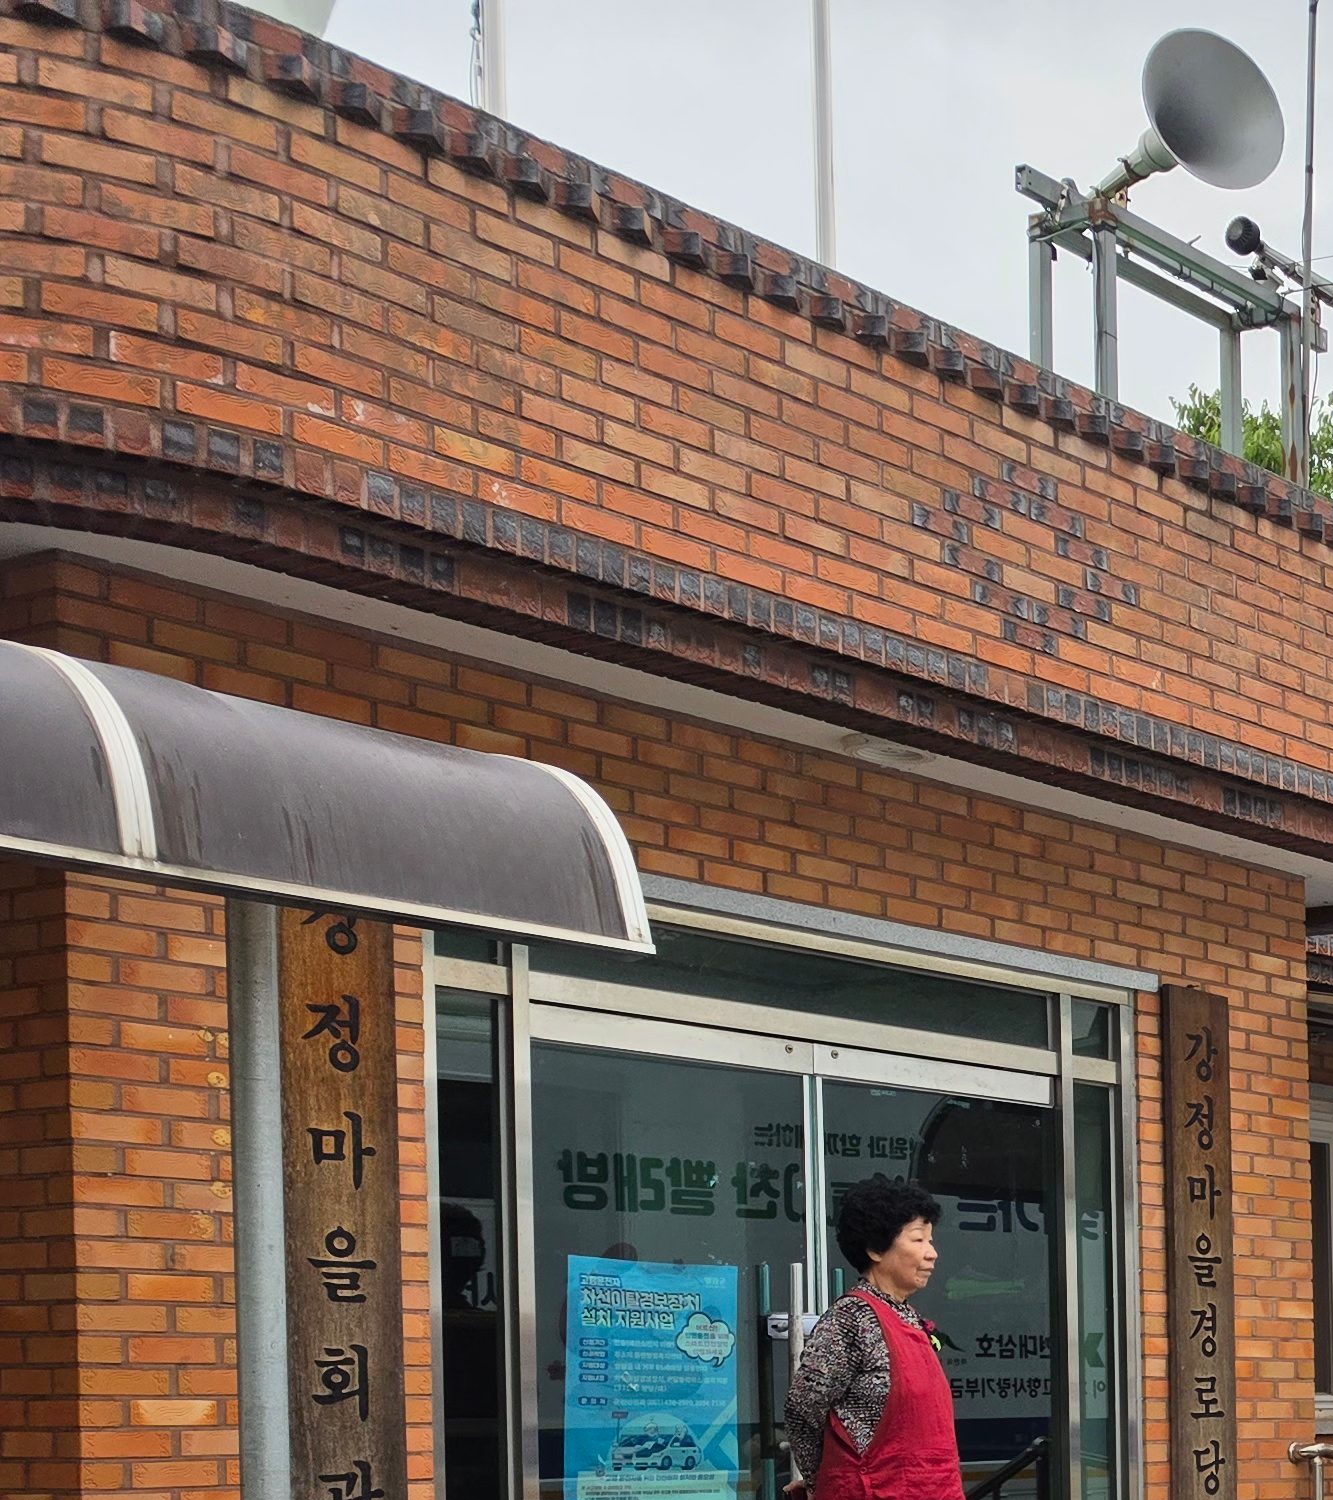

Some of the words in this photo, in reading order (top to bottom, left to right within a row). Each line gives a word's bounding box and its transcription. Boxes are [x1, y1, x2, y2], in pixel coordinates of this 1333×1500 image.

[1184, 1026, 1226, 1495] 강정마을경로당
[581, 1286, 700, 1312] 차선이탈경보장치
[581, 1308, 611, 1328] 설치
[615, 1310, 676, 1331] 지원사업
